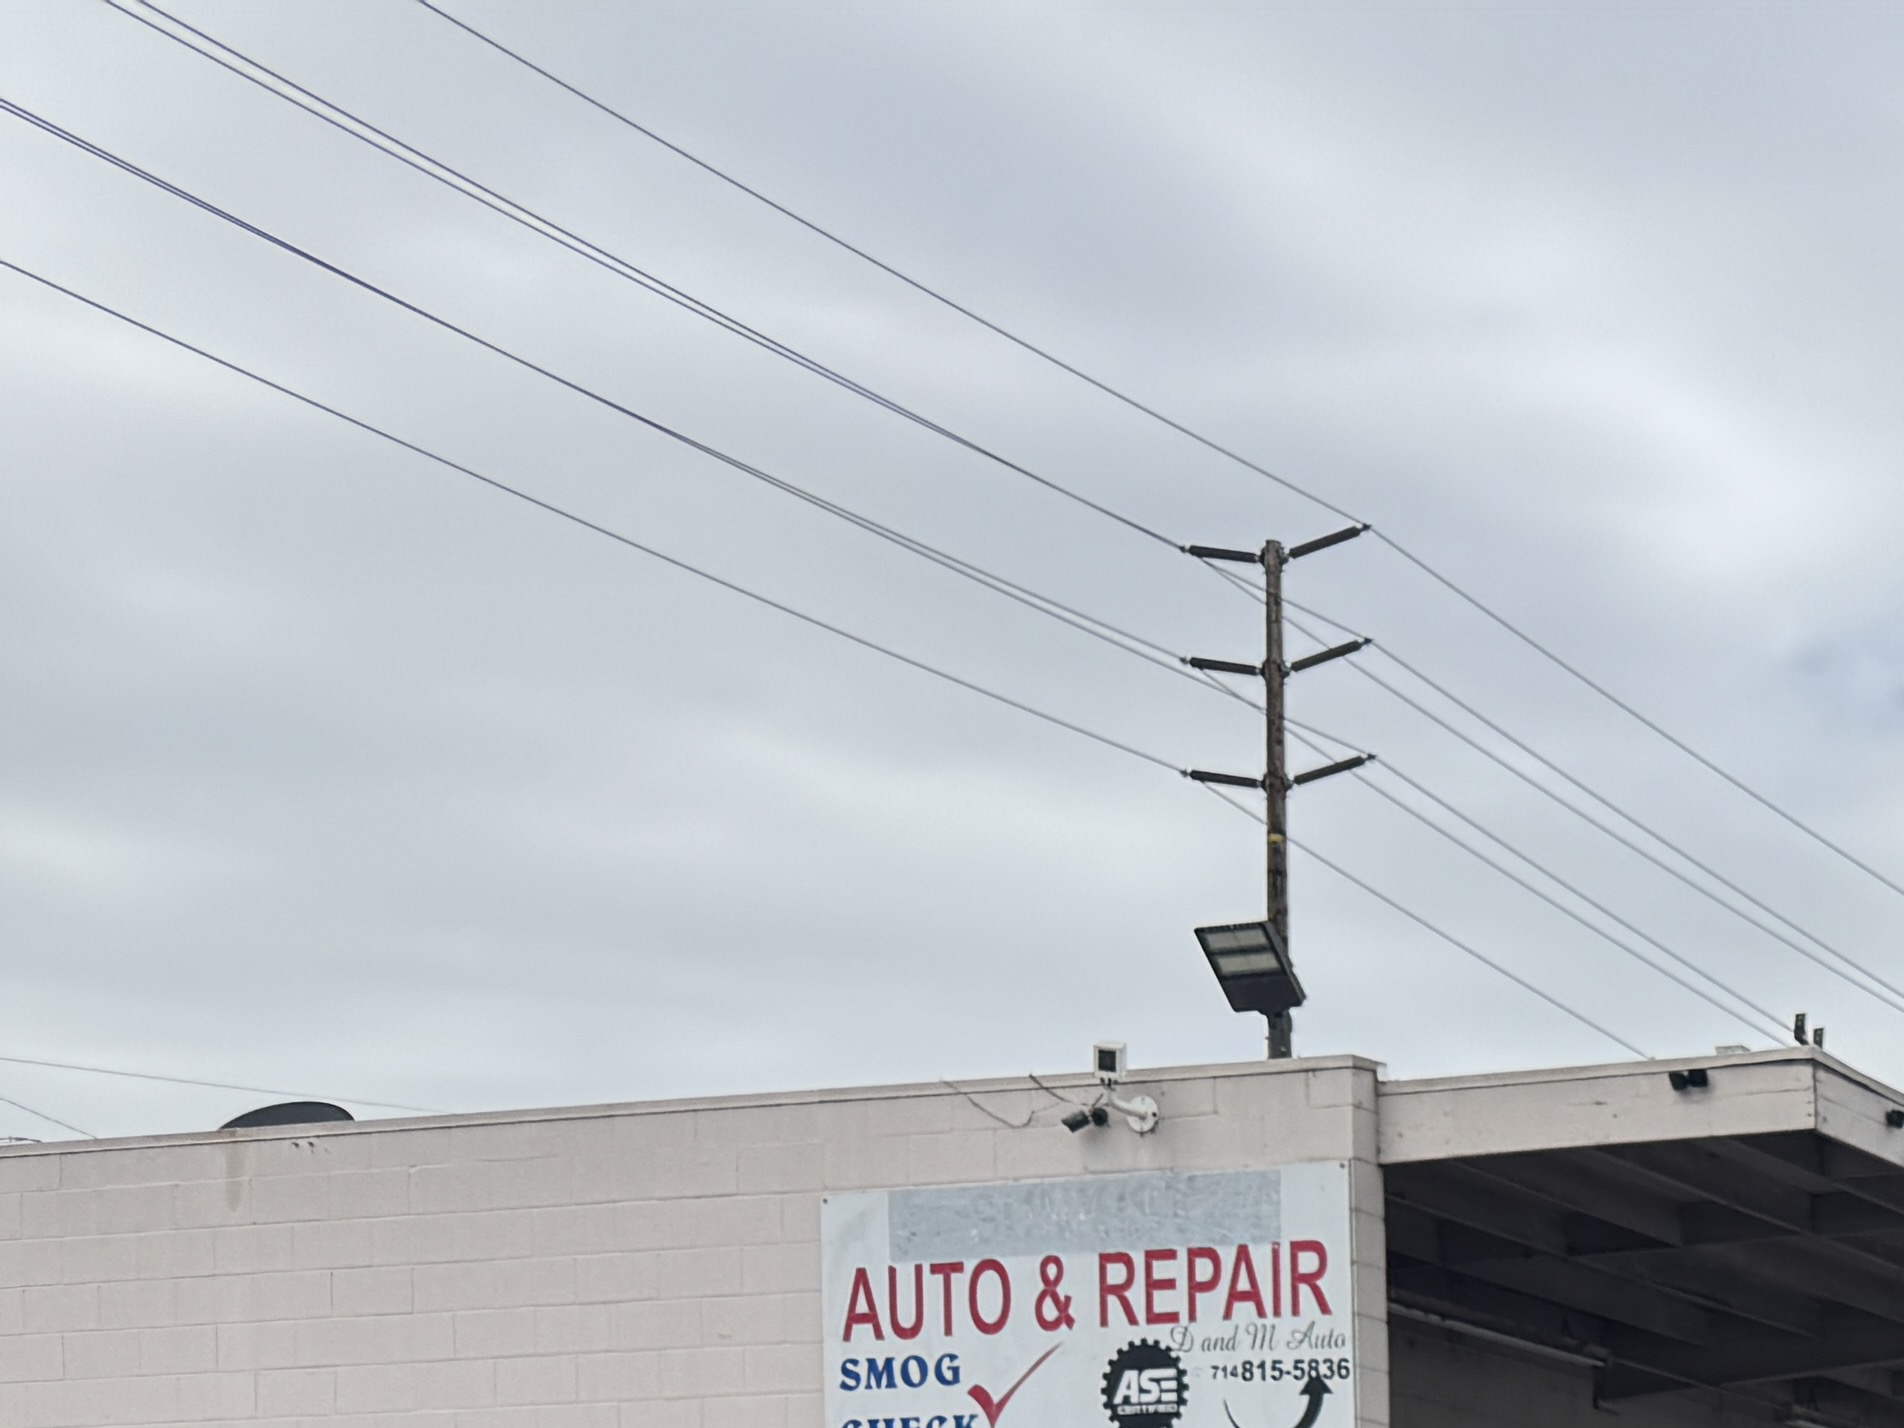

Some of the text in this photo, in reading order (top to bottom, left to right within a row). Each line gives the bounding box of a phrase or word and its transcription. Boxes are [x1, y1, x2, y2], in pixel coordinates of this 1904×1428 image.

[842, 1239, 1334, 1343] AUTO & REPAIR
[1170, 1320, 1347, 1352] D and M Auto
[839, 1352, 961, 1392] SMOG
[1112, 1367, 1179, 1405] ASE
